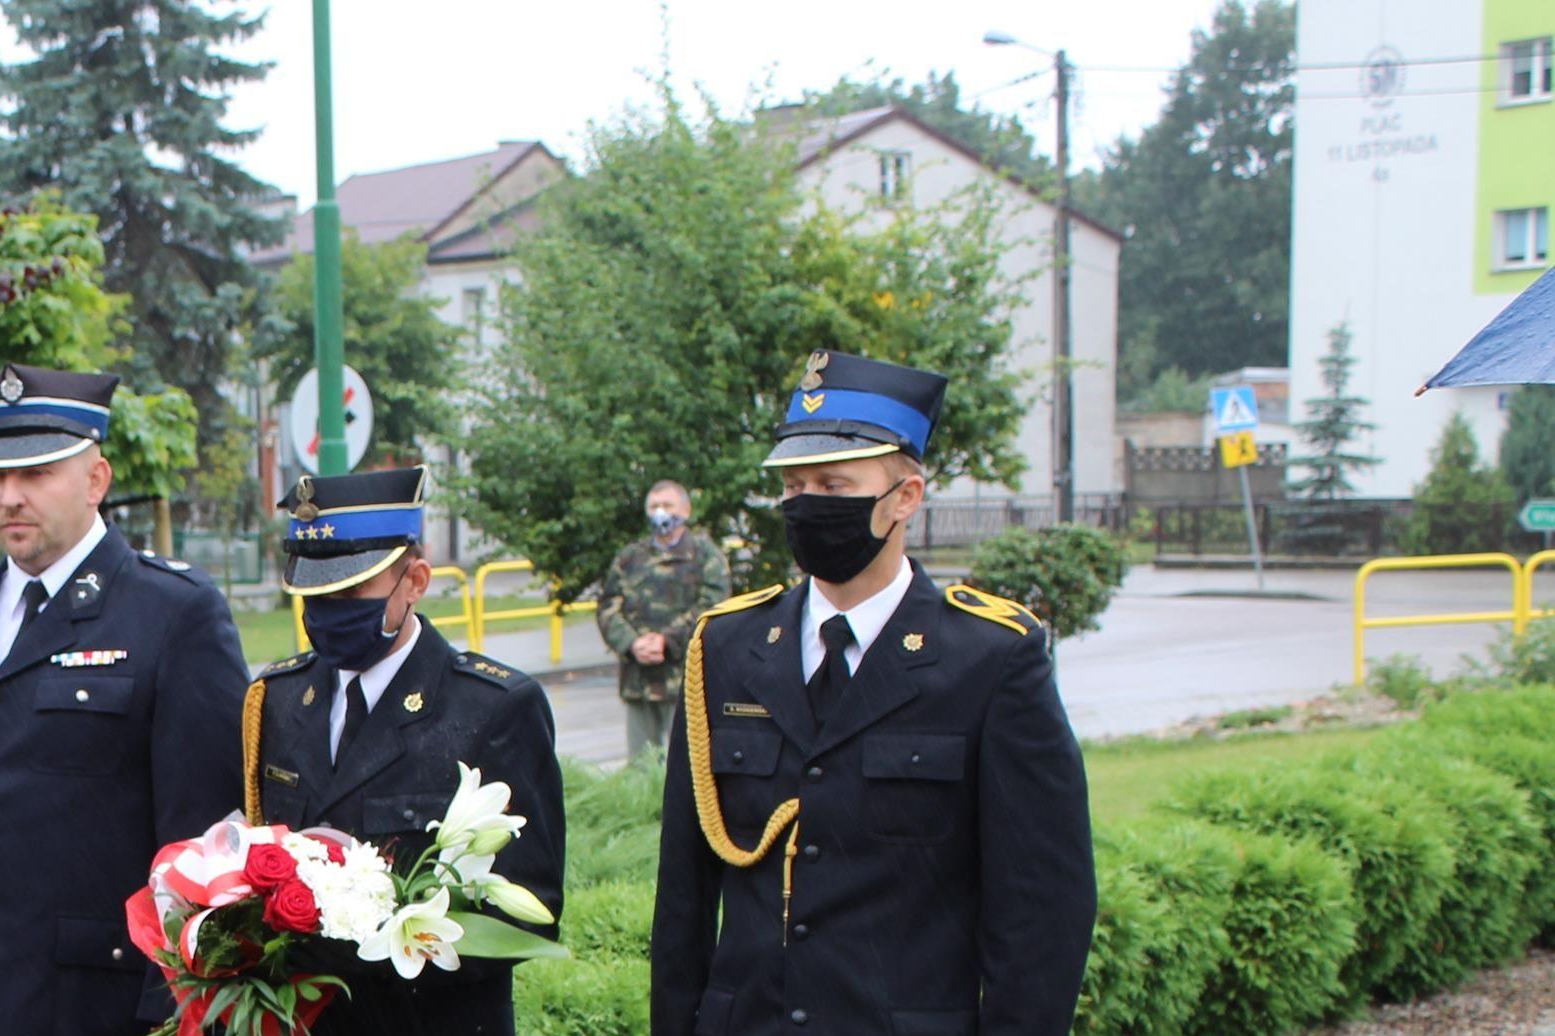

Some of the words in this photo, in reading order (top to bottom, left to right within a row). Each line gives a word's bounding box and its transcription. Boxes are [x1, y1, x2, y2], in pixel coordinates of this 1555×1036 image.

[1360, 112, 1404, 134] PLAC
[1327, 145, 1343, 162] 11
[1346, 134, 1439, 162] LISTOPADA
